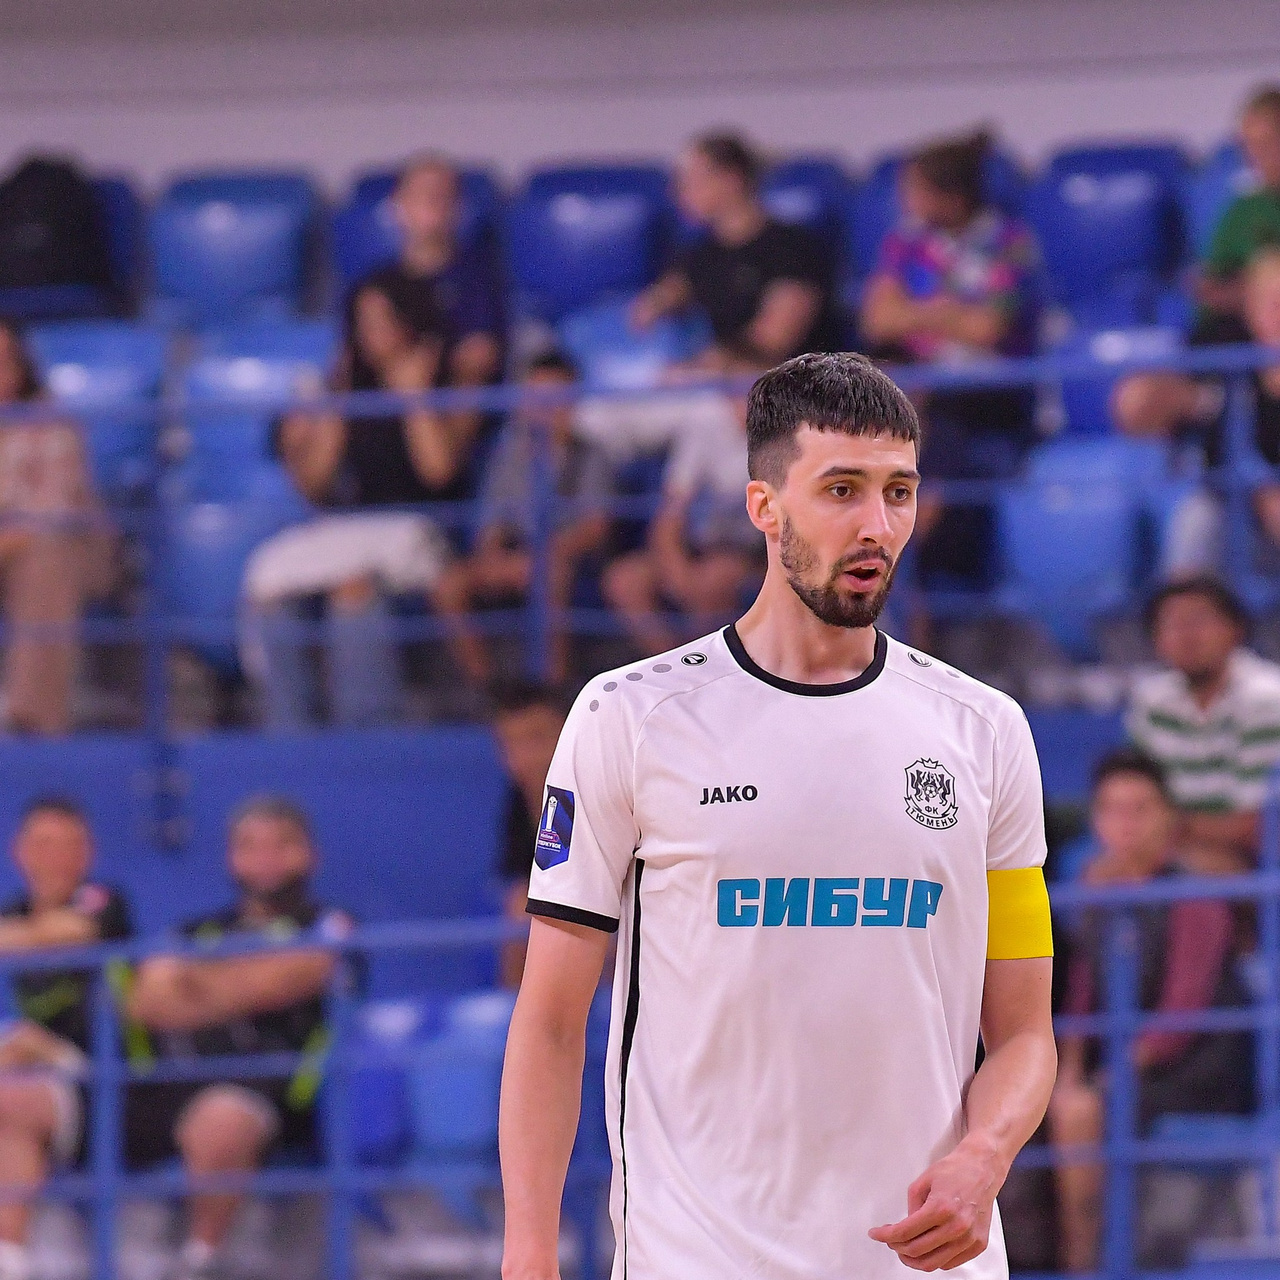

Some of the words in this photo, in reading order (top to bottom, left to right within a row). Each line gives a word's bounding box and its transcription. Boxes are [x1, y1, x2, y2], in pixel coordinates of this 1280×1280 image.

[700, 785, 758, 805] JAKO
[910, 808, 954, 827] ТЮМЕНЬ
[924, 806, 939, 815] ФК
[717, 877, 944, 928] СИБУР
